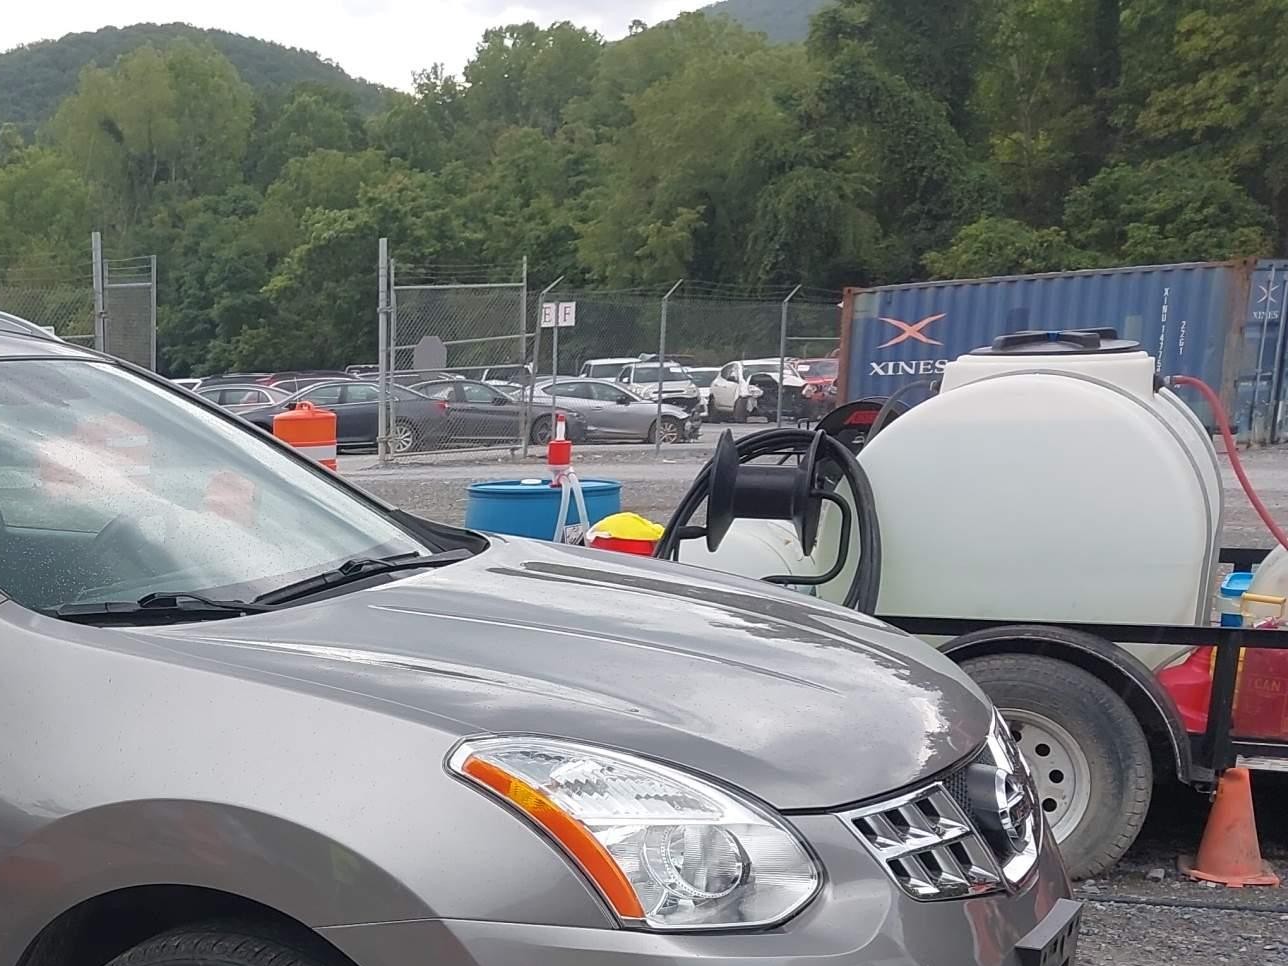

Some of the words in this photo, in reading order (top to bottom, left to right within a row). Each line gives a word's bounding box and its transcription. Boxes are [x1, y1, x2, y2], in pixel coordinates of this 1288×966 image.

[543, 306, 551, 322] E
[563, 306, 571, 322] F
[869, 358, 948, 376] XINES
